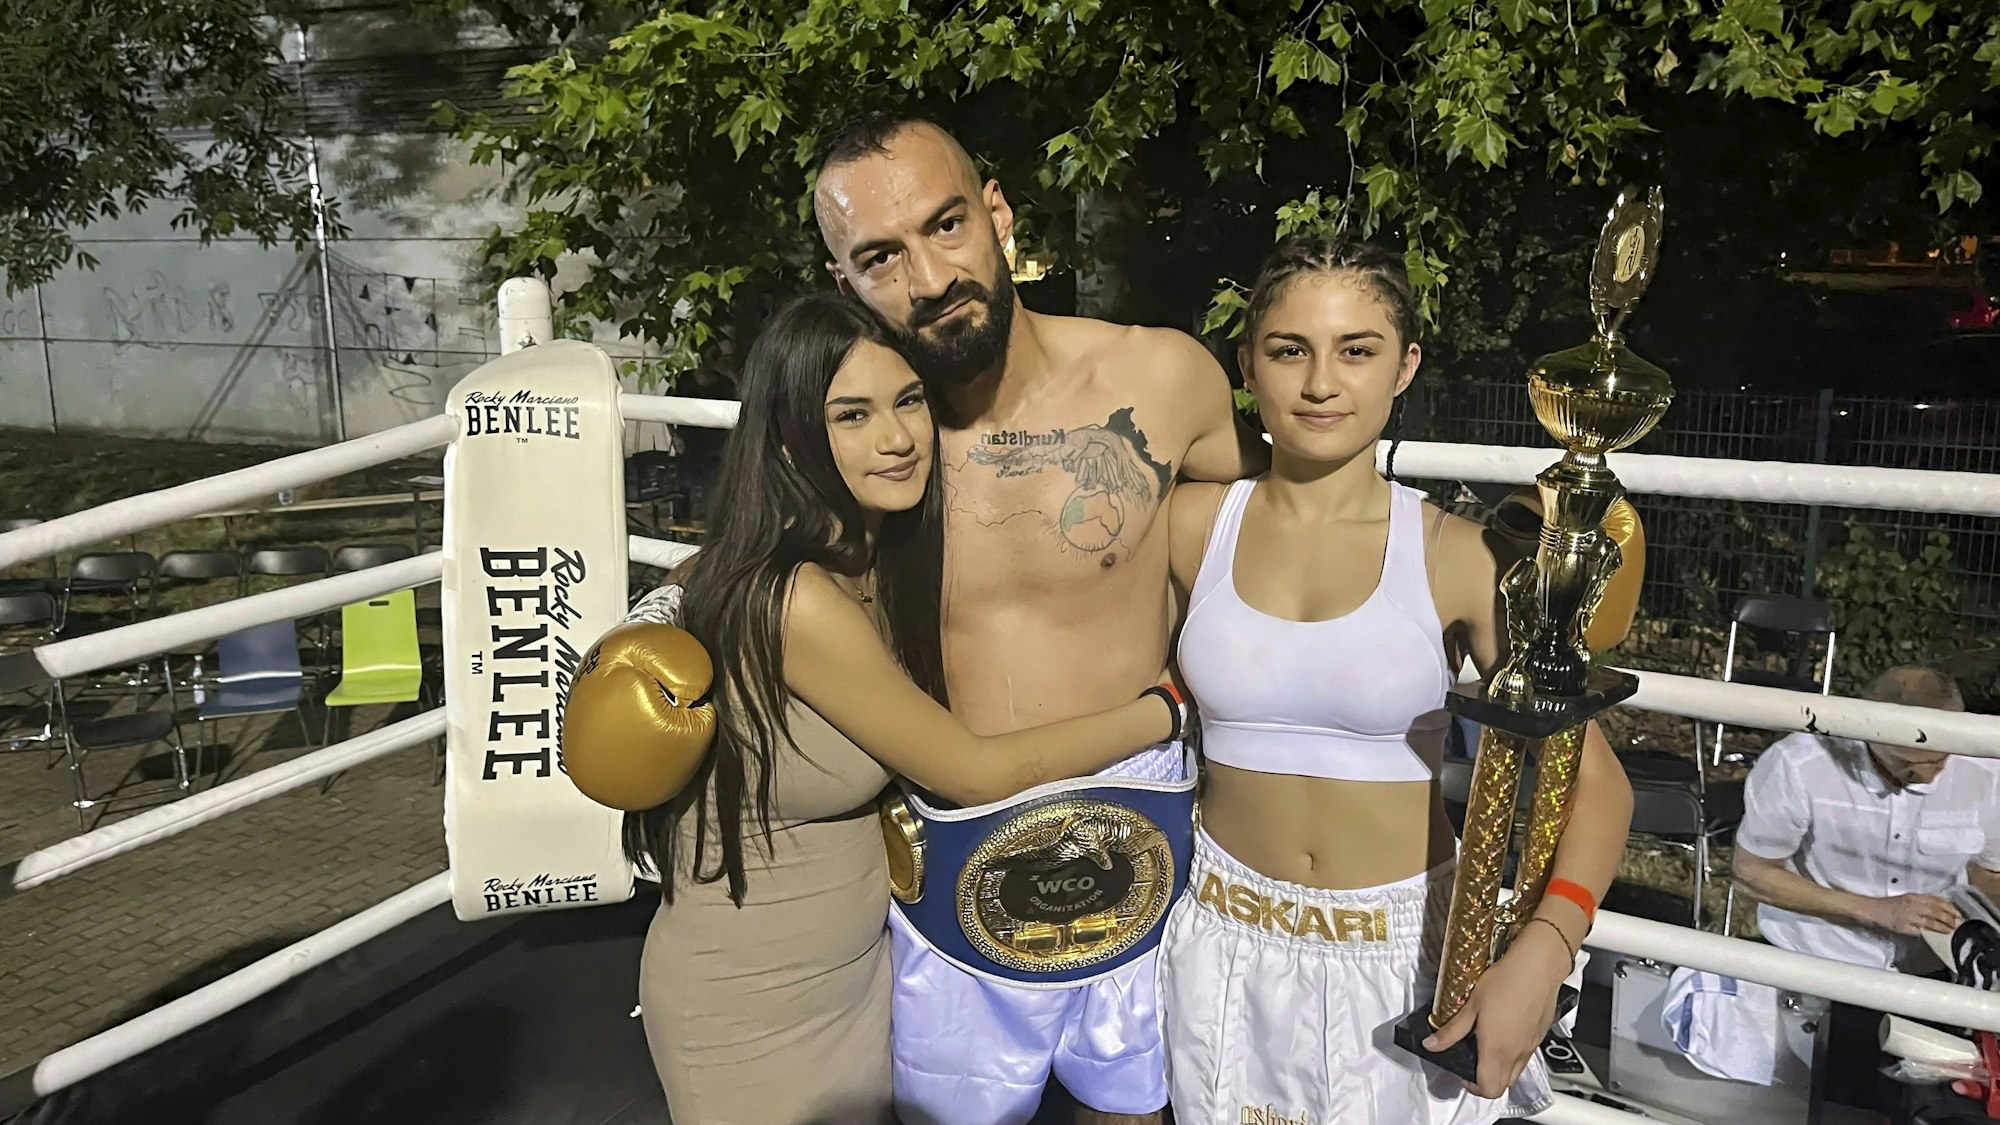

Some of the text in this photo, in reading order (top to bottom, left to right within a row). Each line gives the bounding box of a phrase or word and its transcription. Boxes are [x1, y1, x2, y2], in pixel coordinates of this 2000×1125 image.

[465, 390, 579, 405] Rocky Marciano
[465, 405, 580, 439] BENLEE
[550, 547, 586, 629] Rocky
[471, 651, 482, 675] TM
[479, 546, 551, 781] BENLEE
[483, 878, 525, 892] Rocky
[484, 883, 598, 912] BENLEE
[1036, 876, 1095, 894] WCO
[1029, 889, 1104, 912] ORGANIZATION
[1200, 872, 1388, 942] ASKARI
